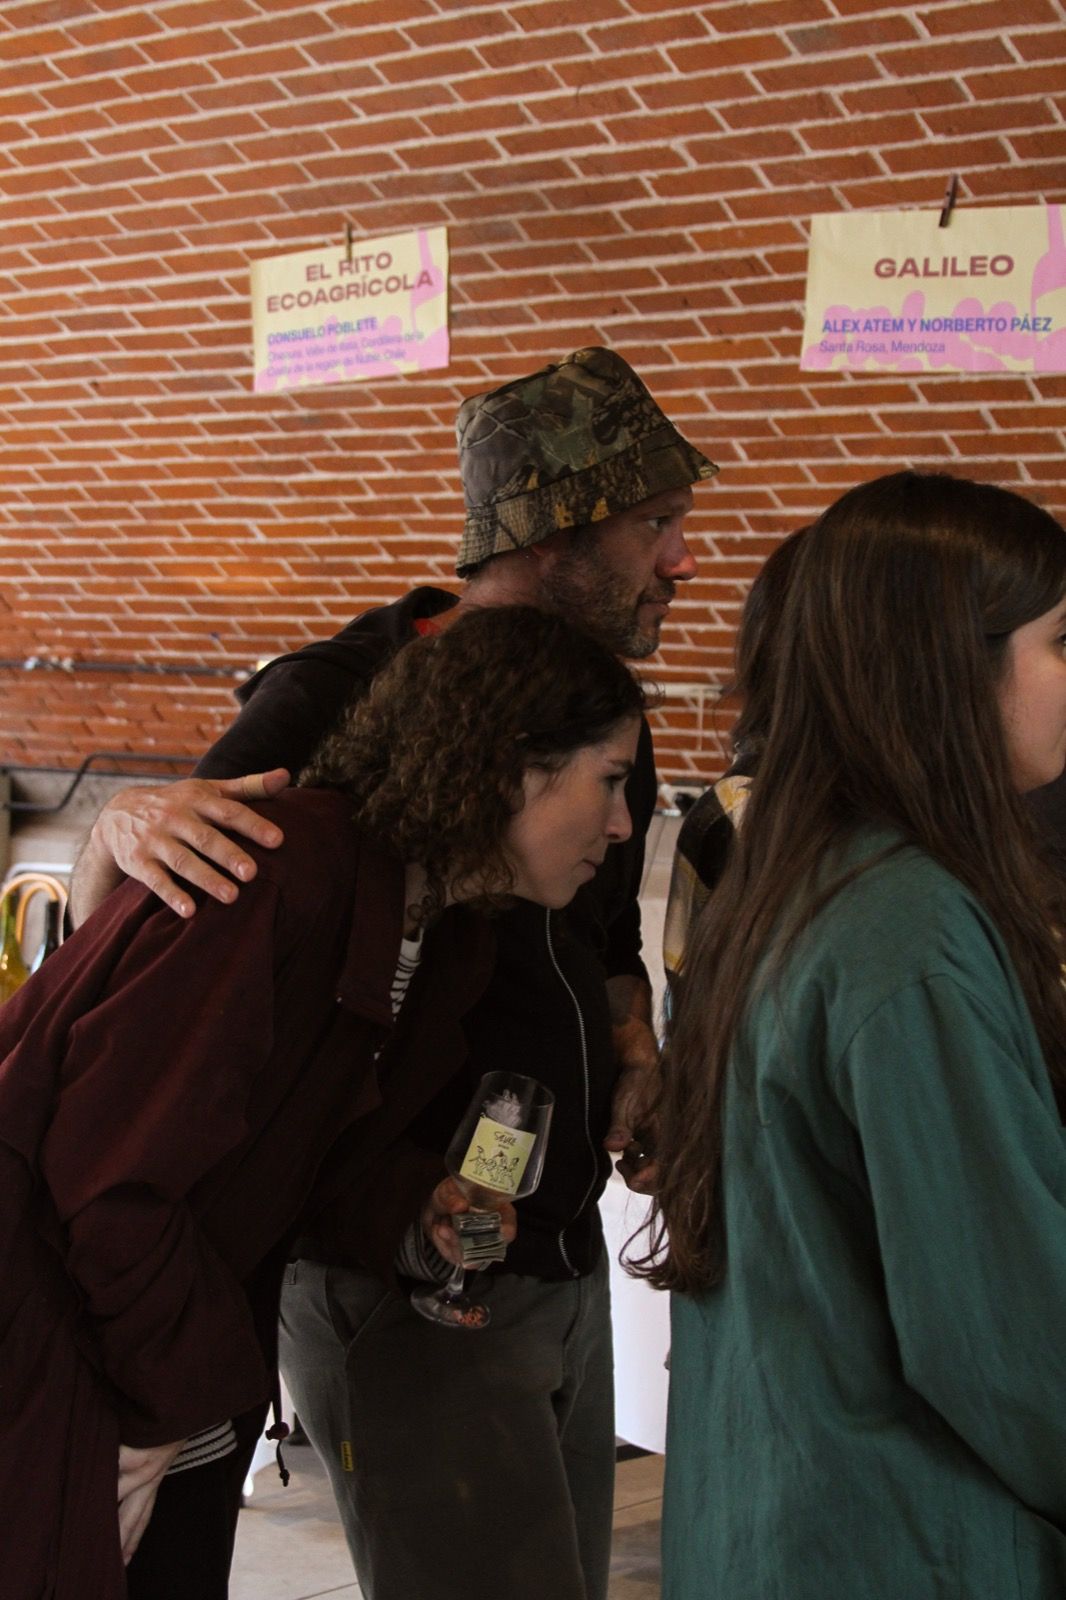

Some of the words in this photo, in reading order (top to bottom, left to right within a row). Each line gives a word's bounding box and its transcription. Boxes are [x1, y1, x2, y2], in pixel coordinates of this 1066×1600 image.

[306, 264, 331, 282] EL
[338, 252, 393, 277] RITO
[873, 255, 1014, 279] GALILEO
[266, 270, 433, 313] ECOAGRÍCOLA
[268, 325, 326, 345] CONSUELO
[327, 317, 377, 336] POBLETE
[822, 319, 860, 333] ALEX
[863, 318, 904, 333] ATEM
[904, 318, 916, 333] Y
[920, 317, 1007, 332] NORBERTO
[1010, 313, 1052, 332] PÁEZ
[819, 340, 853, 354] Santa
[855, 340, 886, 354] Rosa,
[891, 339, 946, 353] Mendoza
